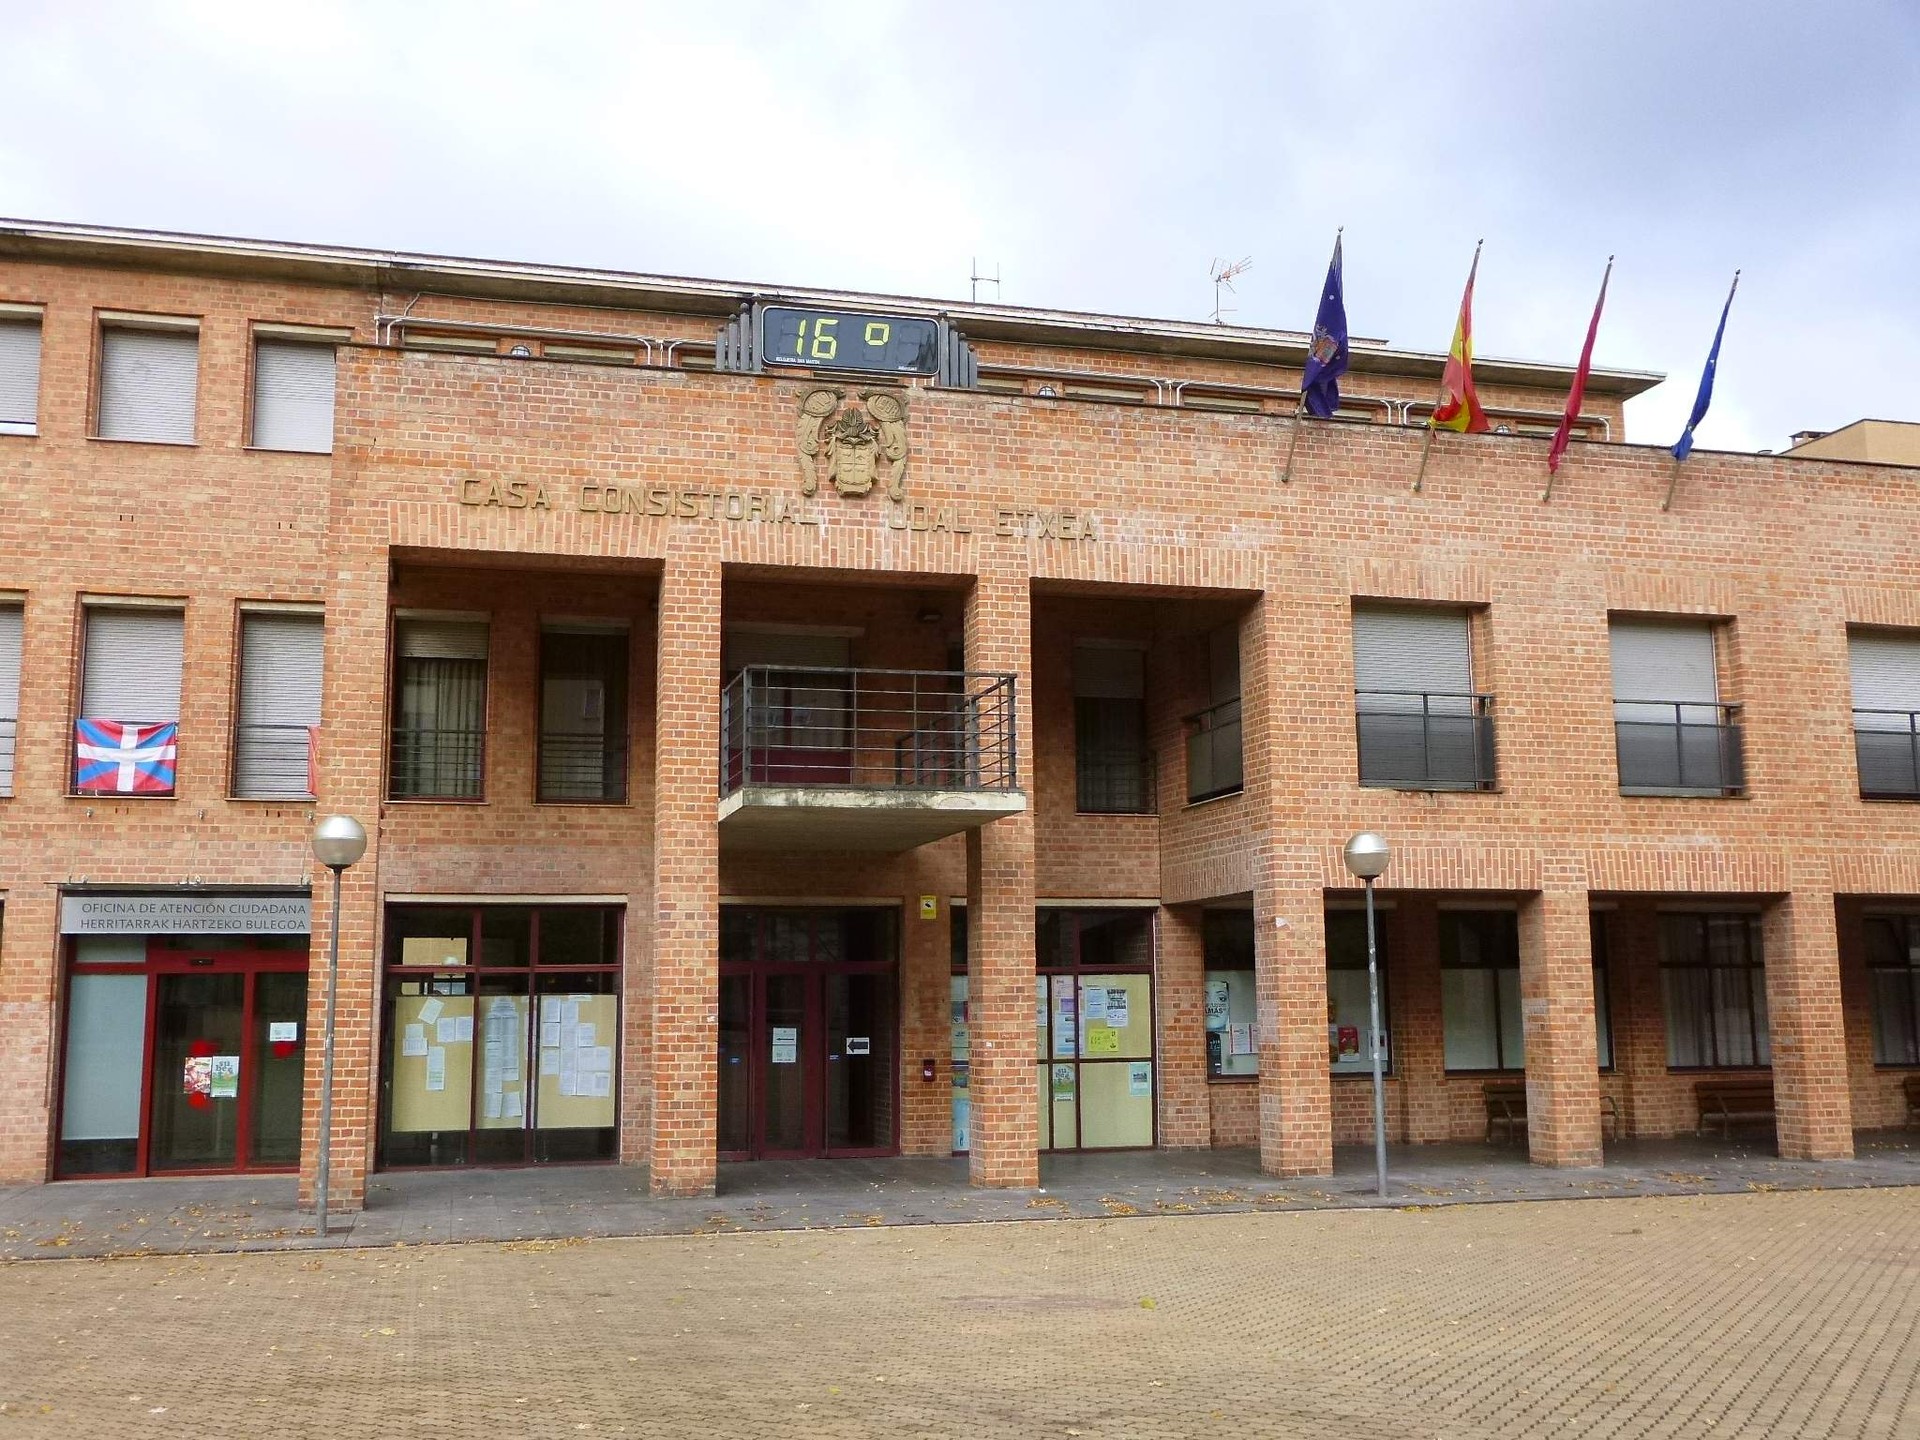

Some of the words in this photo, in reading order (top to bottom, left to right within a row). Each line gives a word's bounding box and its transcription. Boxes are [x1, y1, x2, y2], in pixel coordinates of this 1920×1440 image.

[797, 318, 839, 359] 16
[459, 478, 551, 509] CASA
[579, 485, 819, 525] CONSISTORIAL
[888, 501, 972, 533] UDAL
[995, 508, 1097, 541] ETXEA
[80, 918, 170, 930] HERRITARRAK
[173, 919, 242, 930] HARTZEKO
[246, 919, 306, 930] BULEGOA
[81, 903, 135, 914] OFICINA
[139, 904, 156, 914] DE
[159, 902, 225, 914] ATENCIÓN
[229, 903, 306, 914] CIUDADANA
